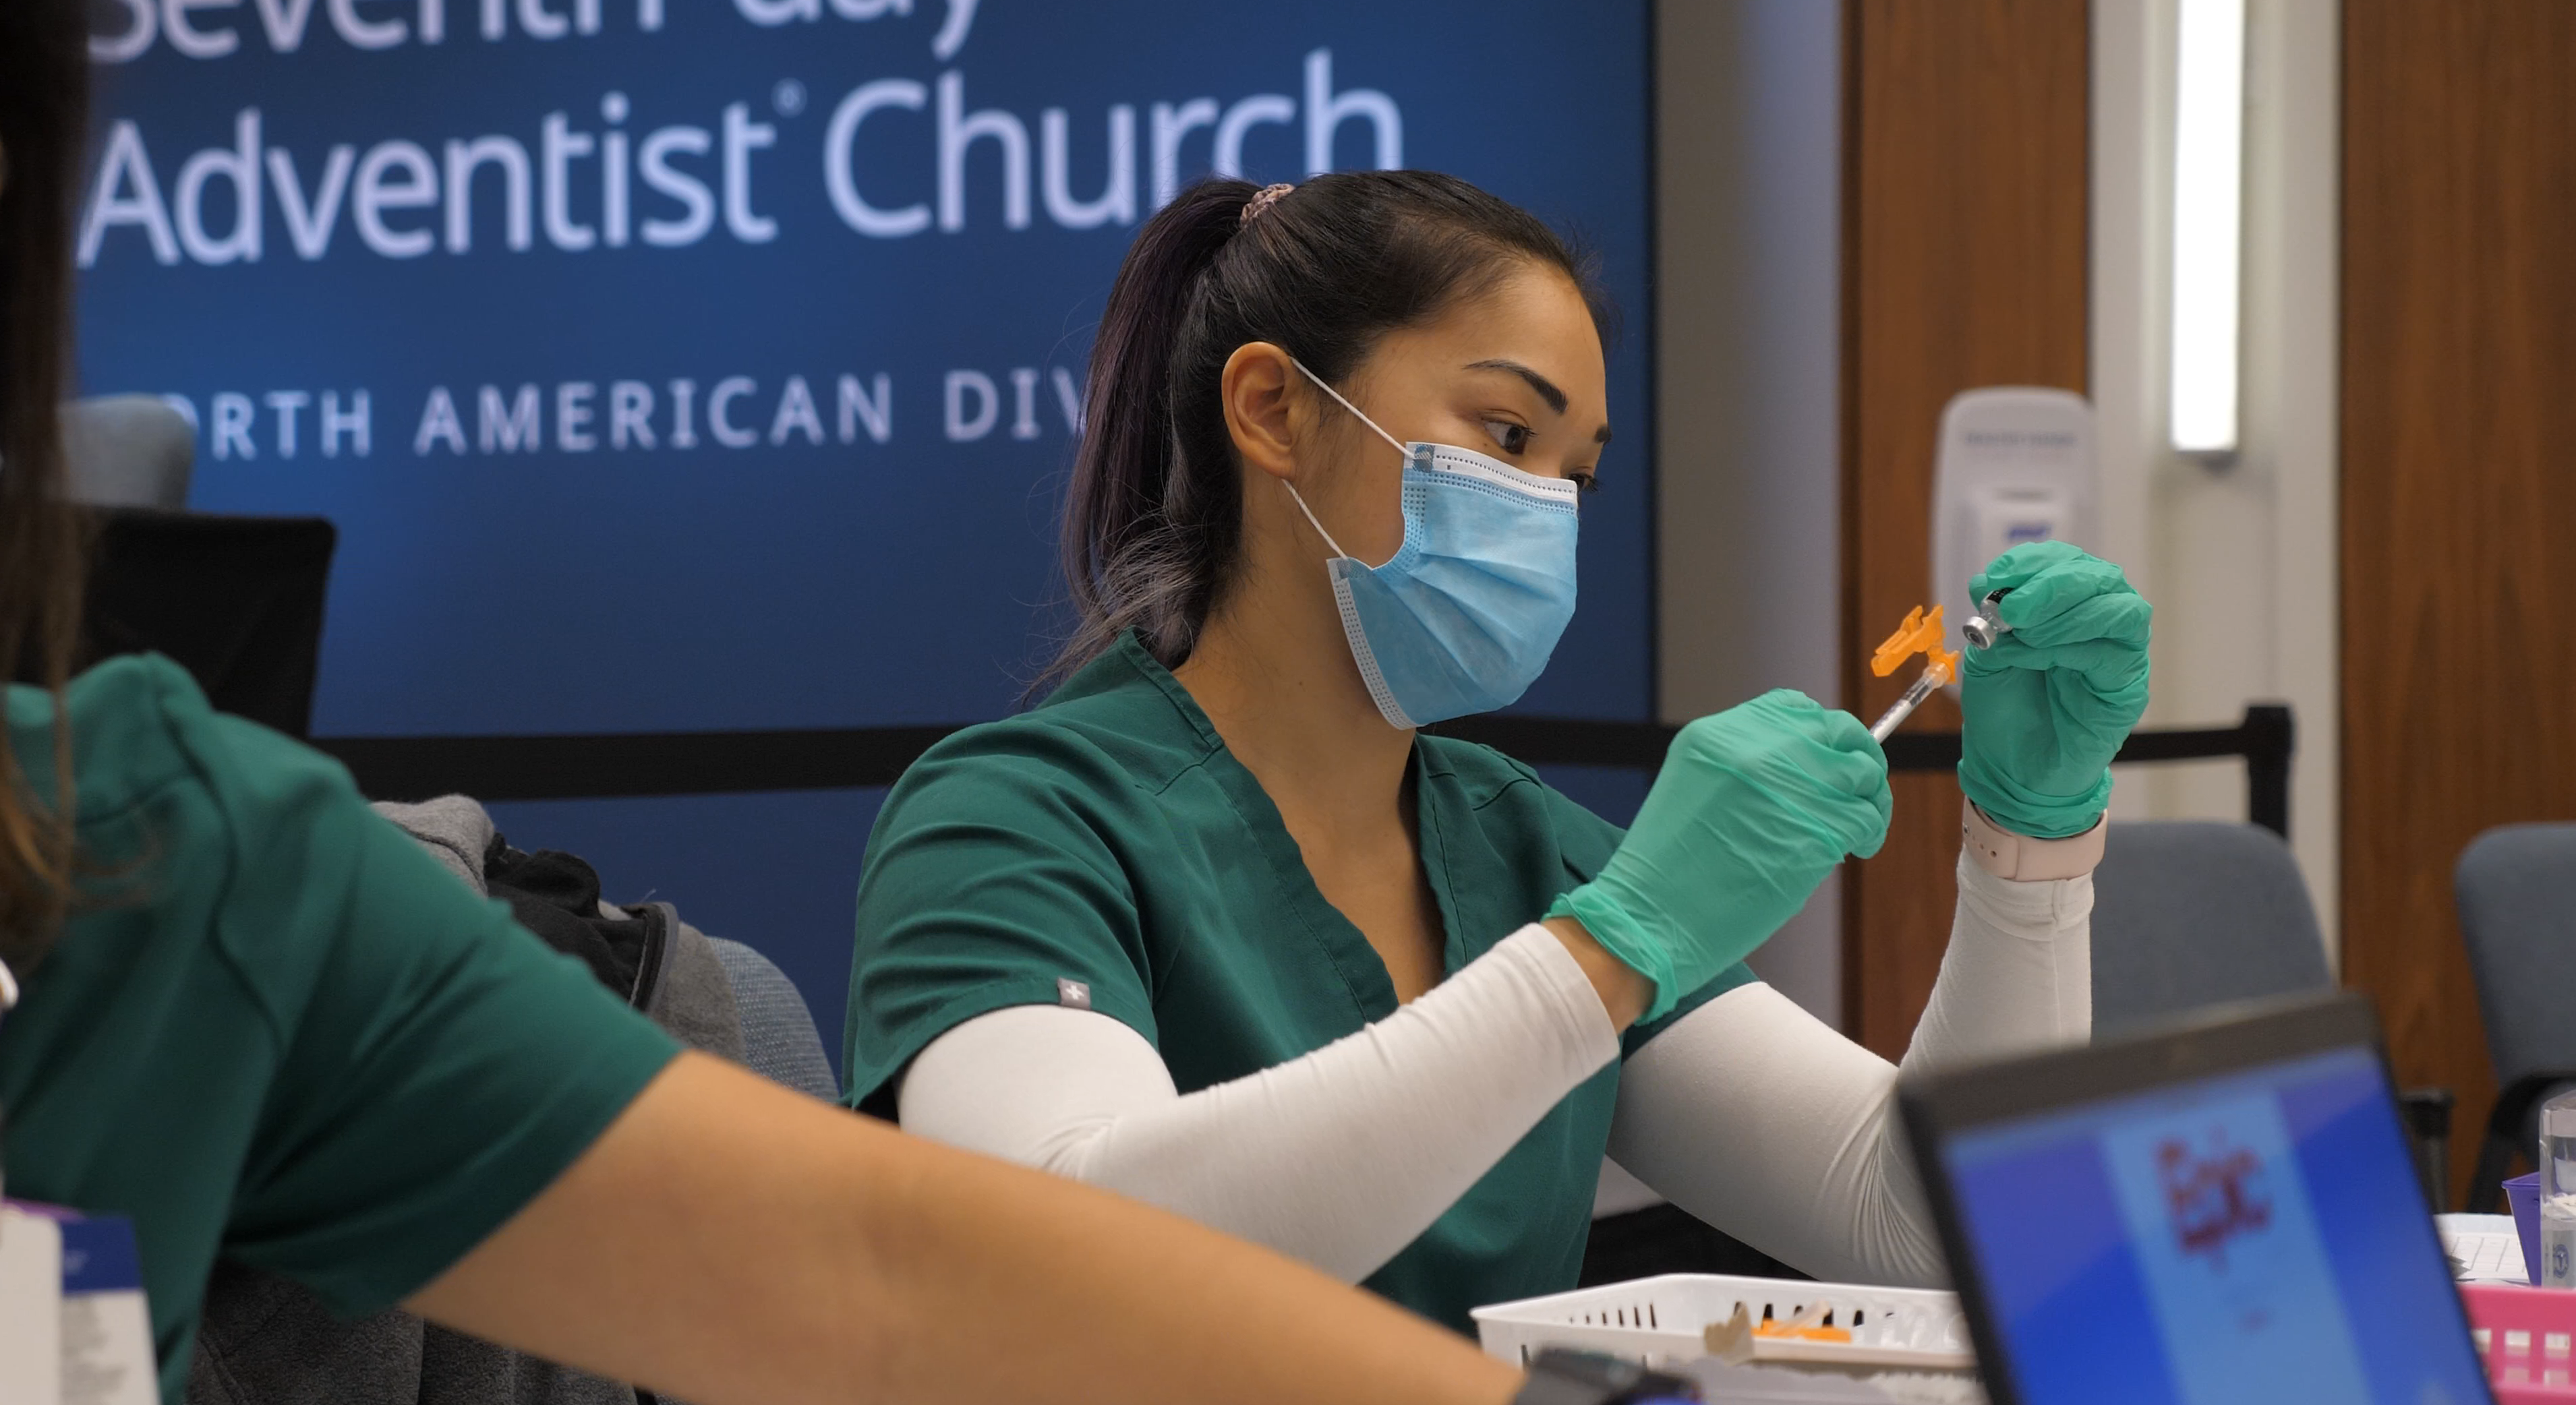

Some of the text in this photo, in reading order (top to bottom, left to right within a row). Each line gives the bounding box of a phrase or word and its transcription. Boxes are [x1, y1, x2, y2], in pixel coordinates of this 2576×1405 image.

[823, 47, 1404, 239] Church
[163, 387, 372, 461] RTH
[413, 372, 893, 456] AMERICAN
